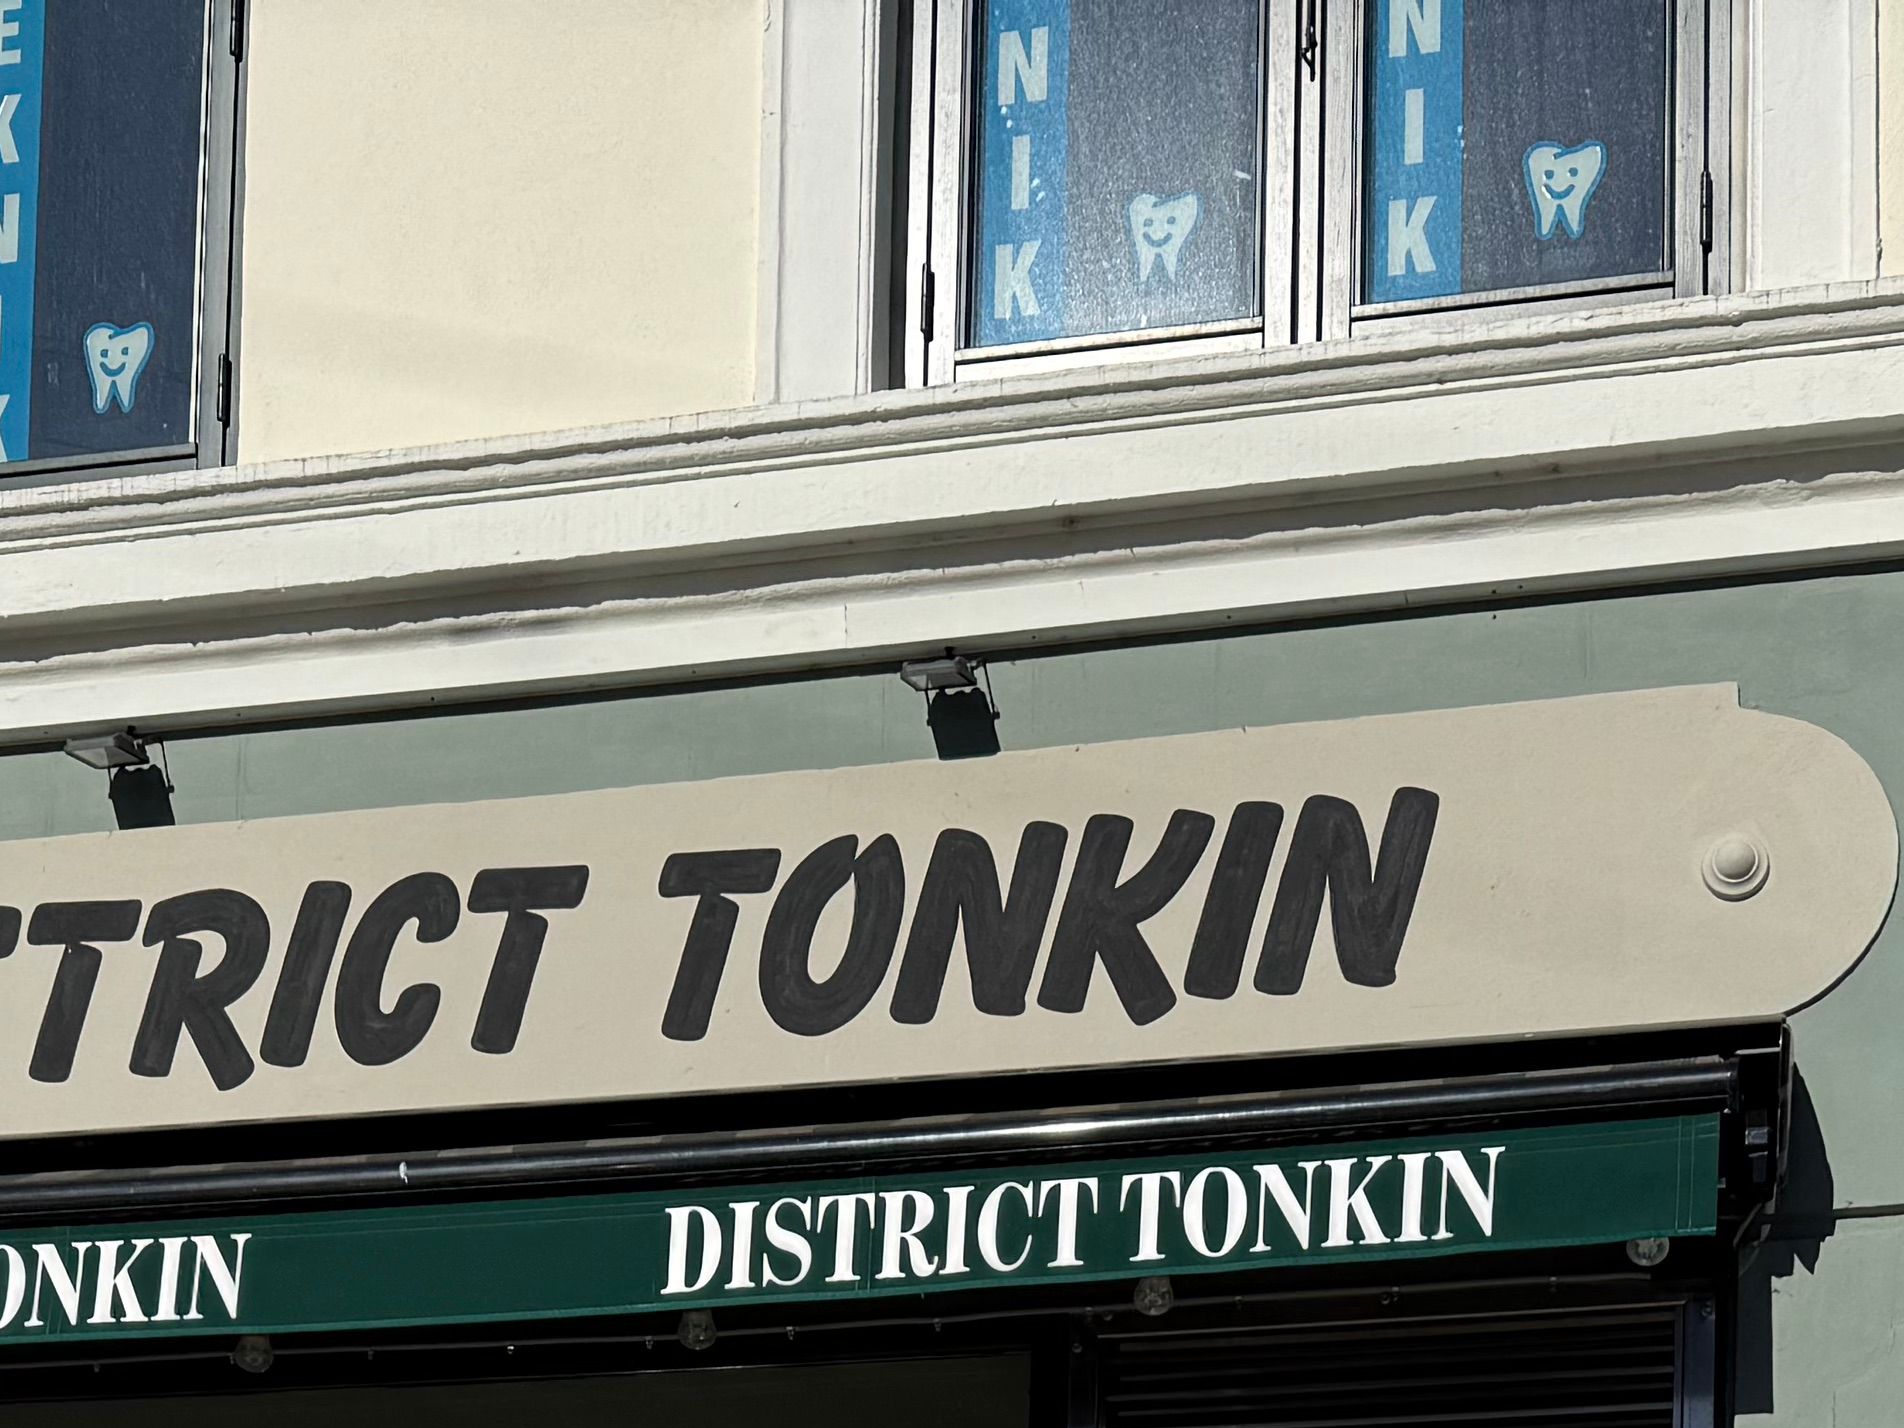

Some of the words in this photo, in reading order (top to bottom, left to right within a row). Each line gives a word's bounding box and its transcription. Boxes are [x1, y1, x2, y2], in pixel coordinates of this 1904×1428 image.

[992, 26, 1051, 321] NIK
[658, 786, 1440, 1042] TONKIN
[660, 1174, 1099, 1296] DISTRICT
[1118, 1145, 1506, 1264] TONKIN
